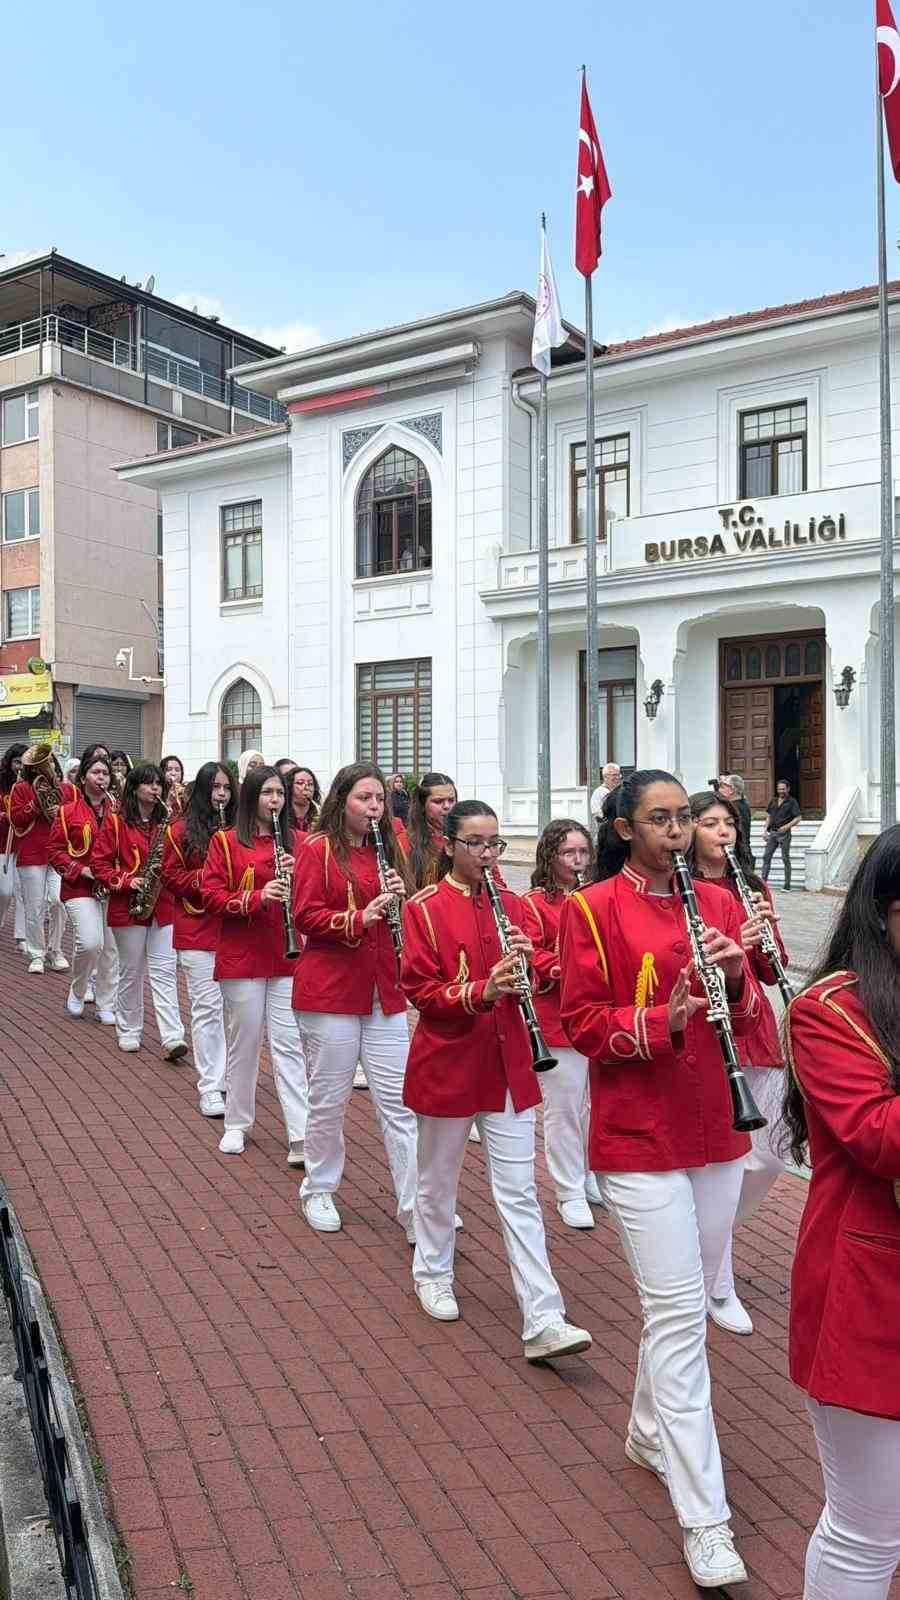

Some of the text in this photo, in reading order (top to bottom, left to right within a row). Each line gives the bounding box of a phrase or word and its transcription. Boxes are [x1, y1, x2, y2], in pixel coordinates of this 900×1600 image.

[718, 505, 764, 528] T.C.
[645, 513, 846, 563] BURSA VALİLİĞİ
